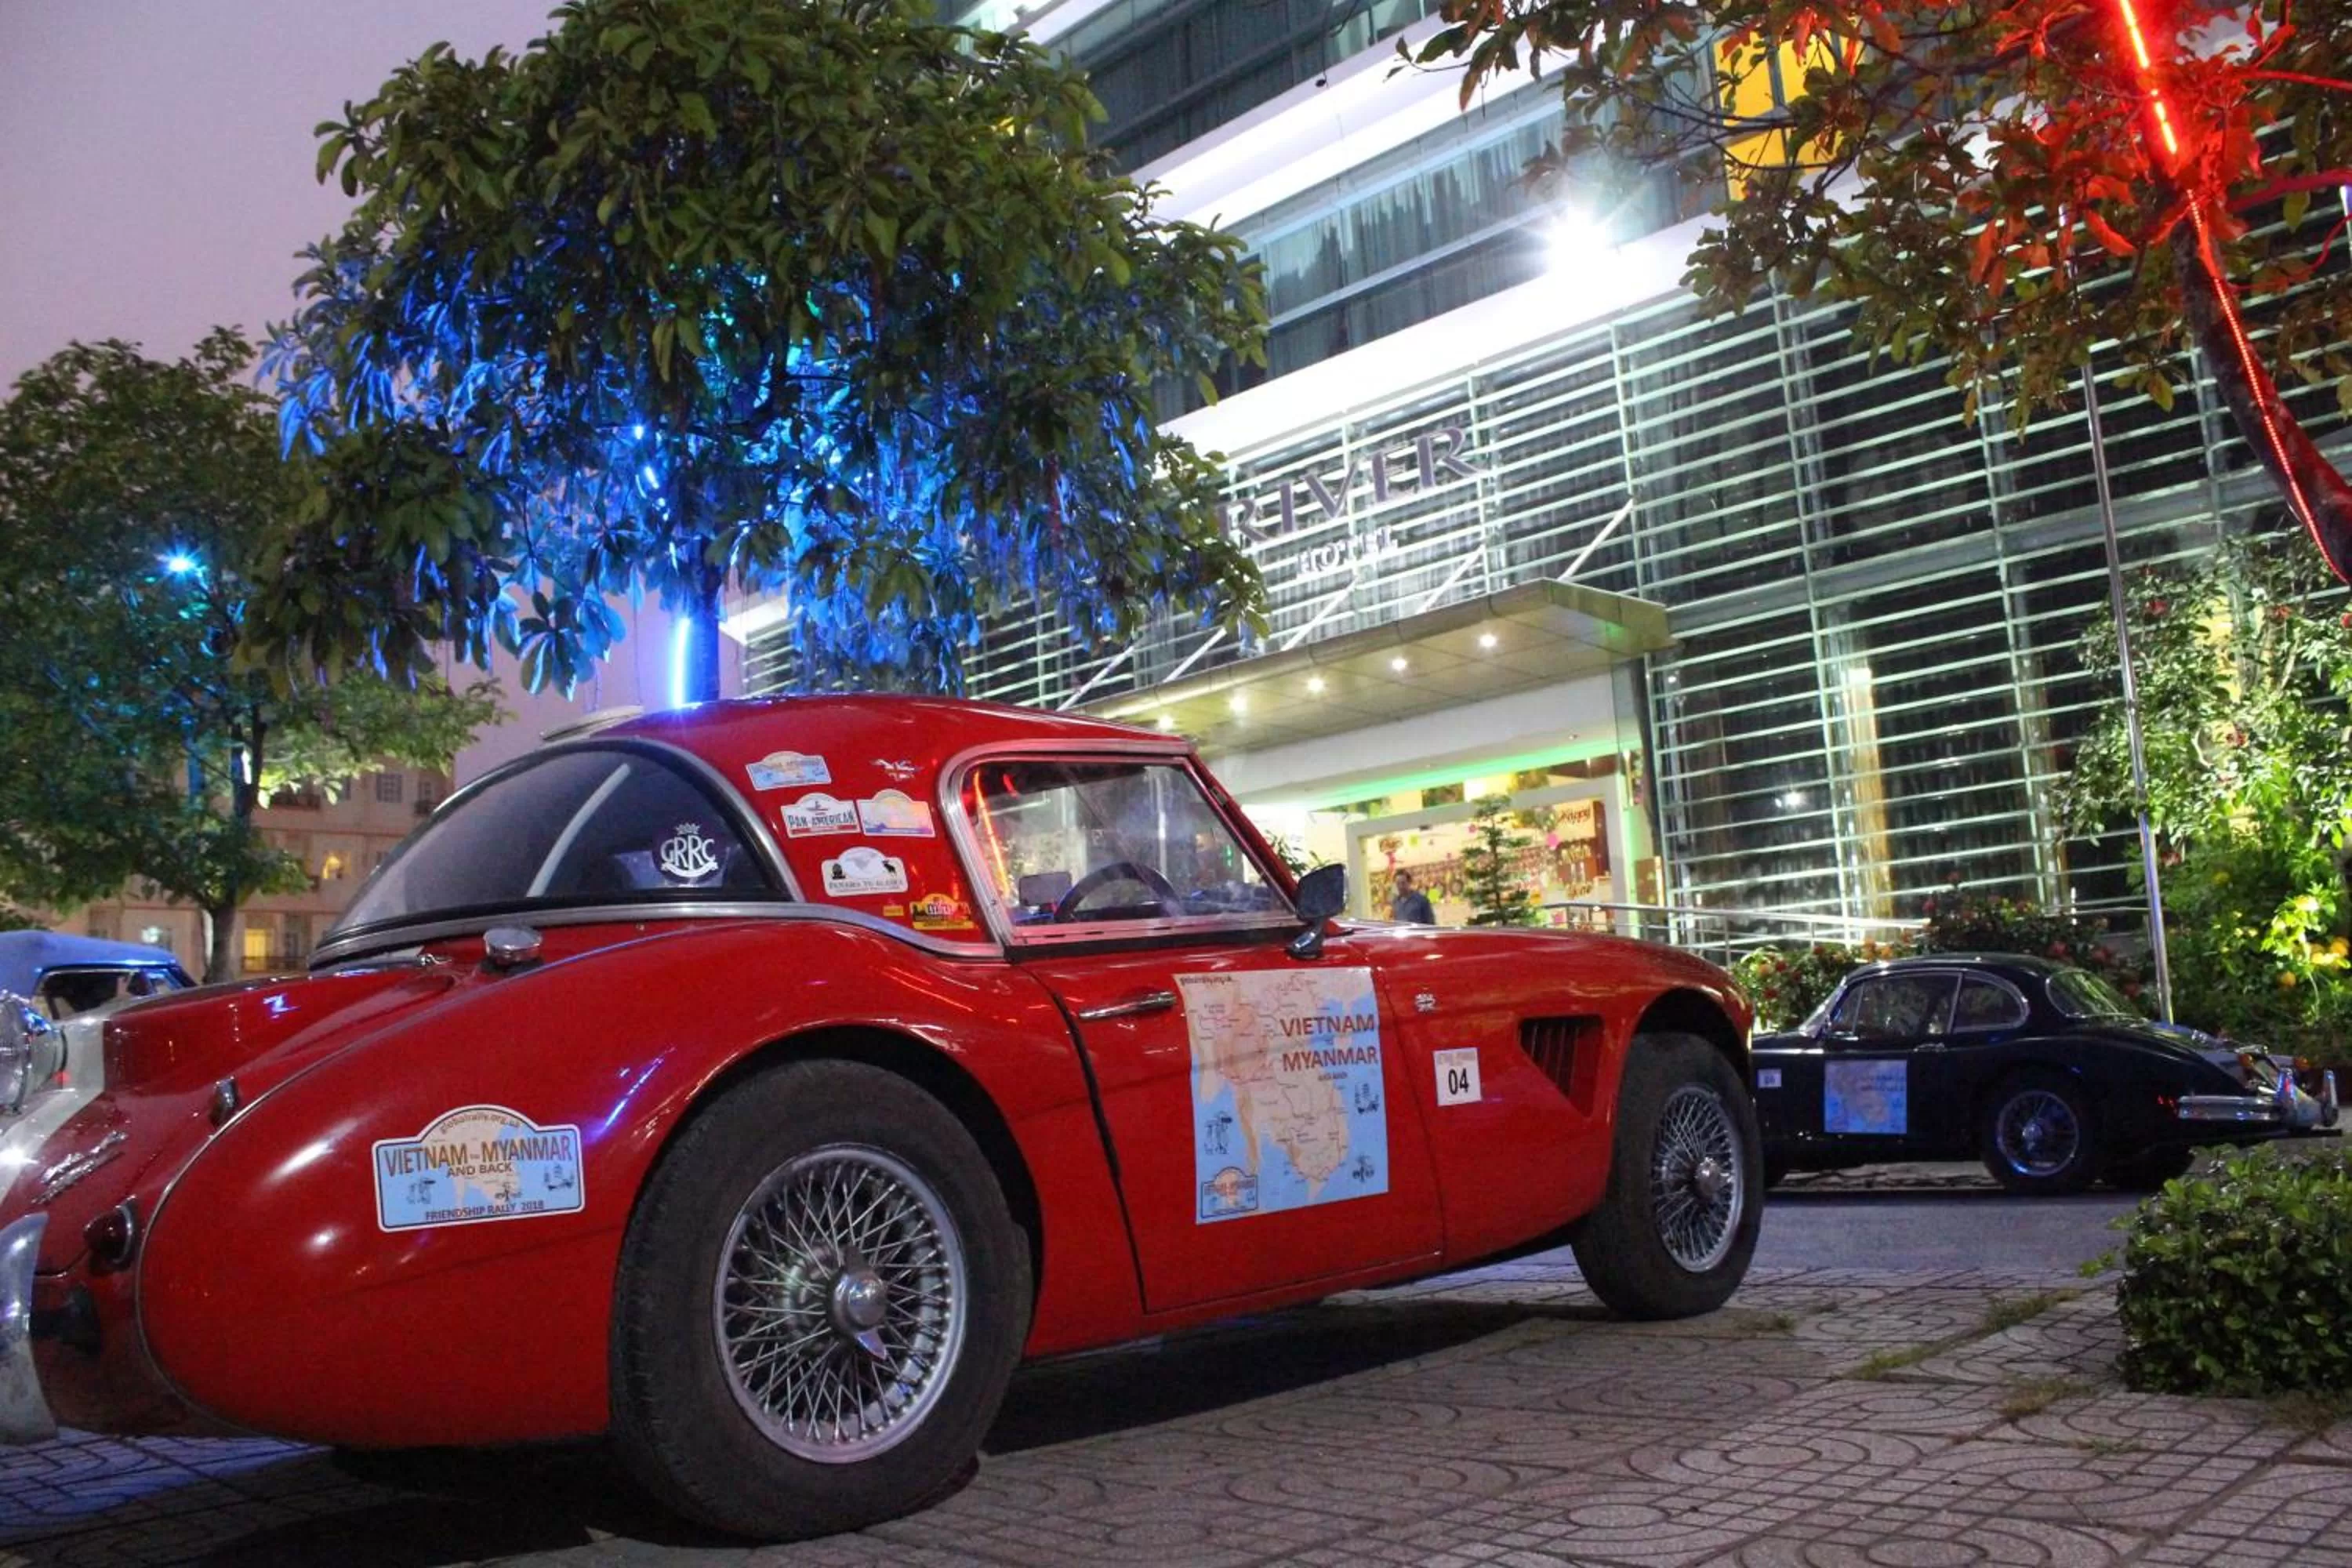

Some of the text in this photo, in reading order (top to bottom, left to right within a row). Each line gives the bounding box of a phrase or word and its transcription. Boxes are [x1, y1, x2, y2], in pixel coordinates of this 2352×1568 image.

[1217, 426, 1482, 543] RIVER
[1298, 525, 1398, 574] HOTEL
[1279, 1013, 1375, 1038] VIETNAM
[1282, 1046, 1379, 1072] MYANMAR
[1448, 1069, 1470, 1095] 04
[383, 1134, 572, 1178] VIETNAM MYANMAR
[446, 1162, 512, 1178] AND BACK
[426, 1205, 485, 1221] FRIENDSHIP
[488, 1202, 516, 1214] RALLY
